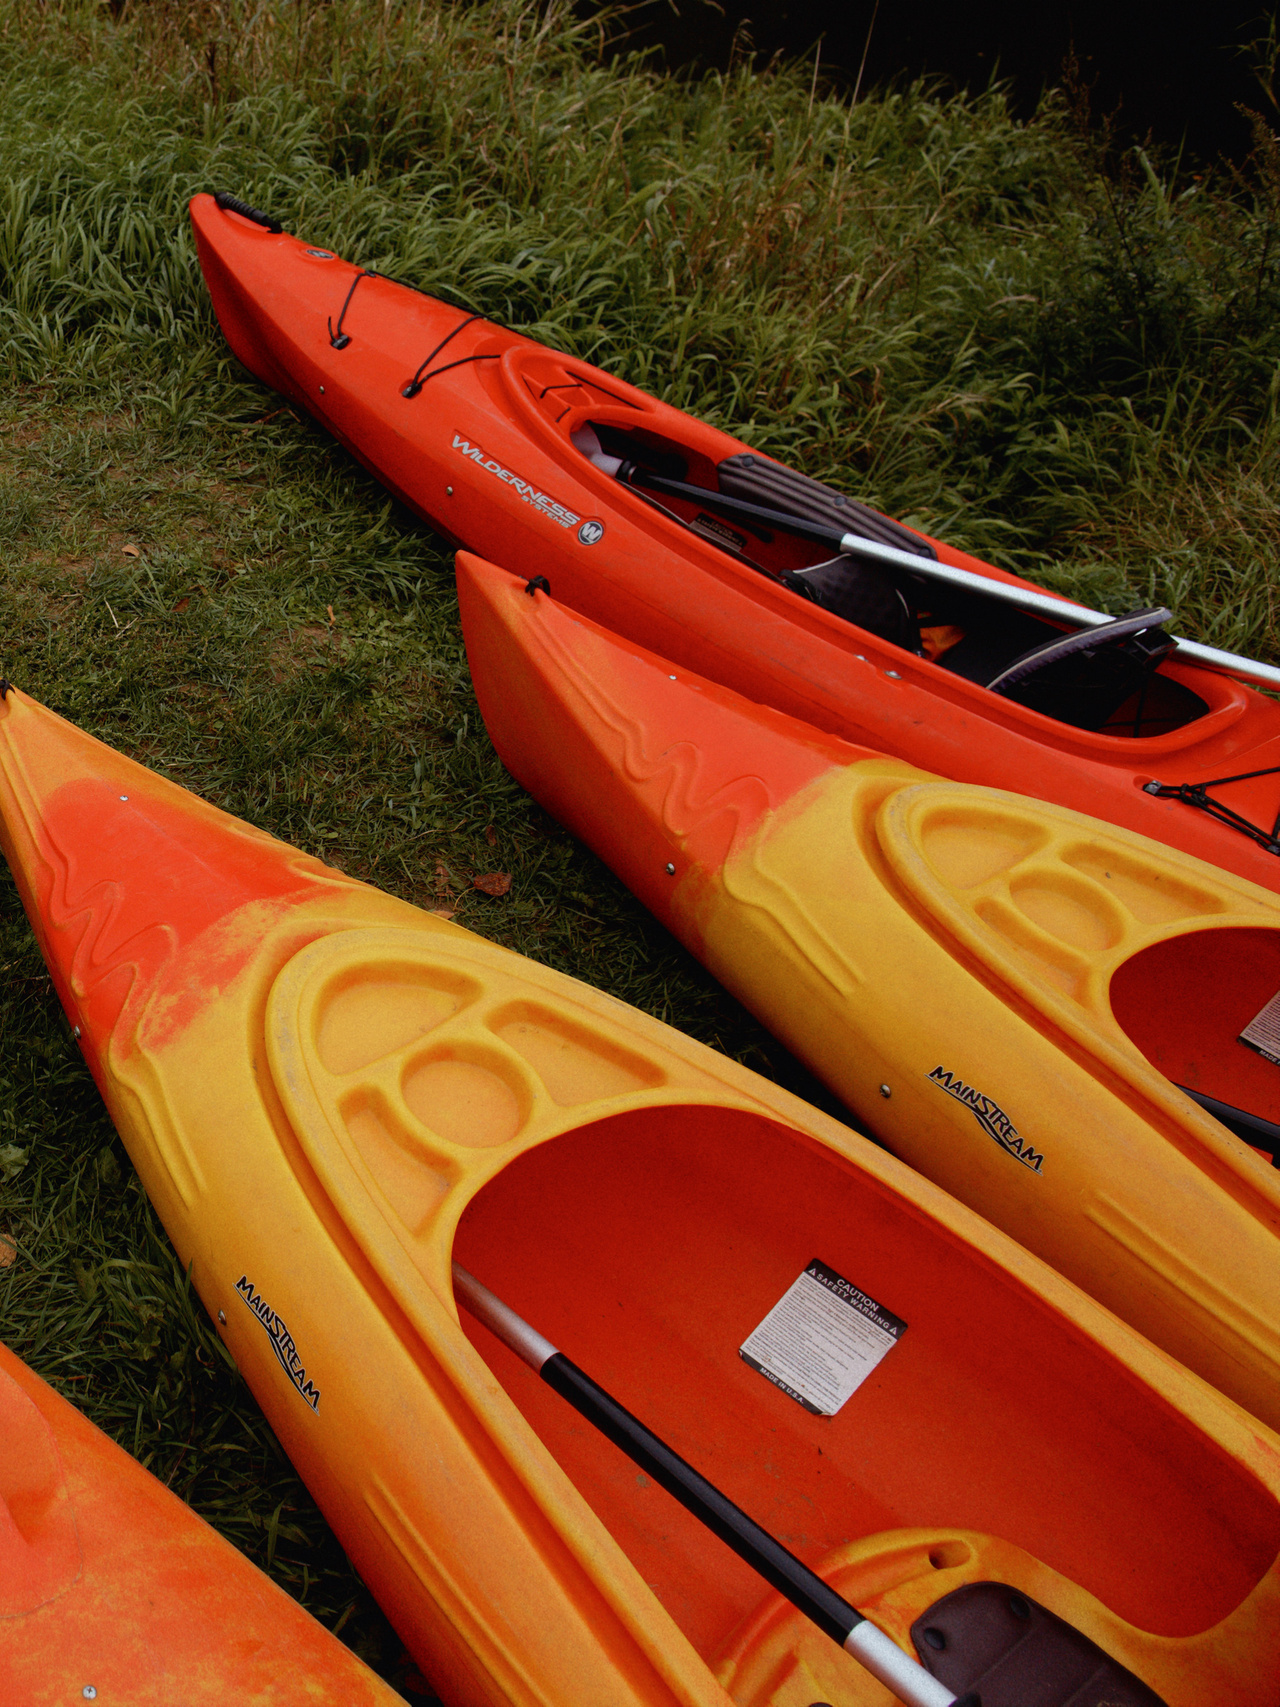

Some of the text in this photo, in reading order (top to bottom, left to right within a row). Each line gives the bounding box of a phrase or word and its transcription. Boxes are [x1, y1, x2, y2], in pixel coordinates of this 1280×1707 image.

[452, 434, 581, 526] WILDERNESS
[521, 495, 572, 529] SYSTEMS
[927, 1065, 1044, 1172] MAINSTREAM
[816, 1273, 890, 1329] SAFETY WARNING
[836, 1279, 880, 1312] CAUTION
[234, 1275, 321, 1411] MAINSTREAM
[759, 1367, 778, 1383] MADE
[778, 1381, 787, 1390] IN
